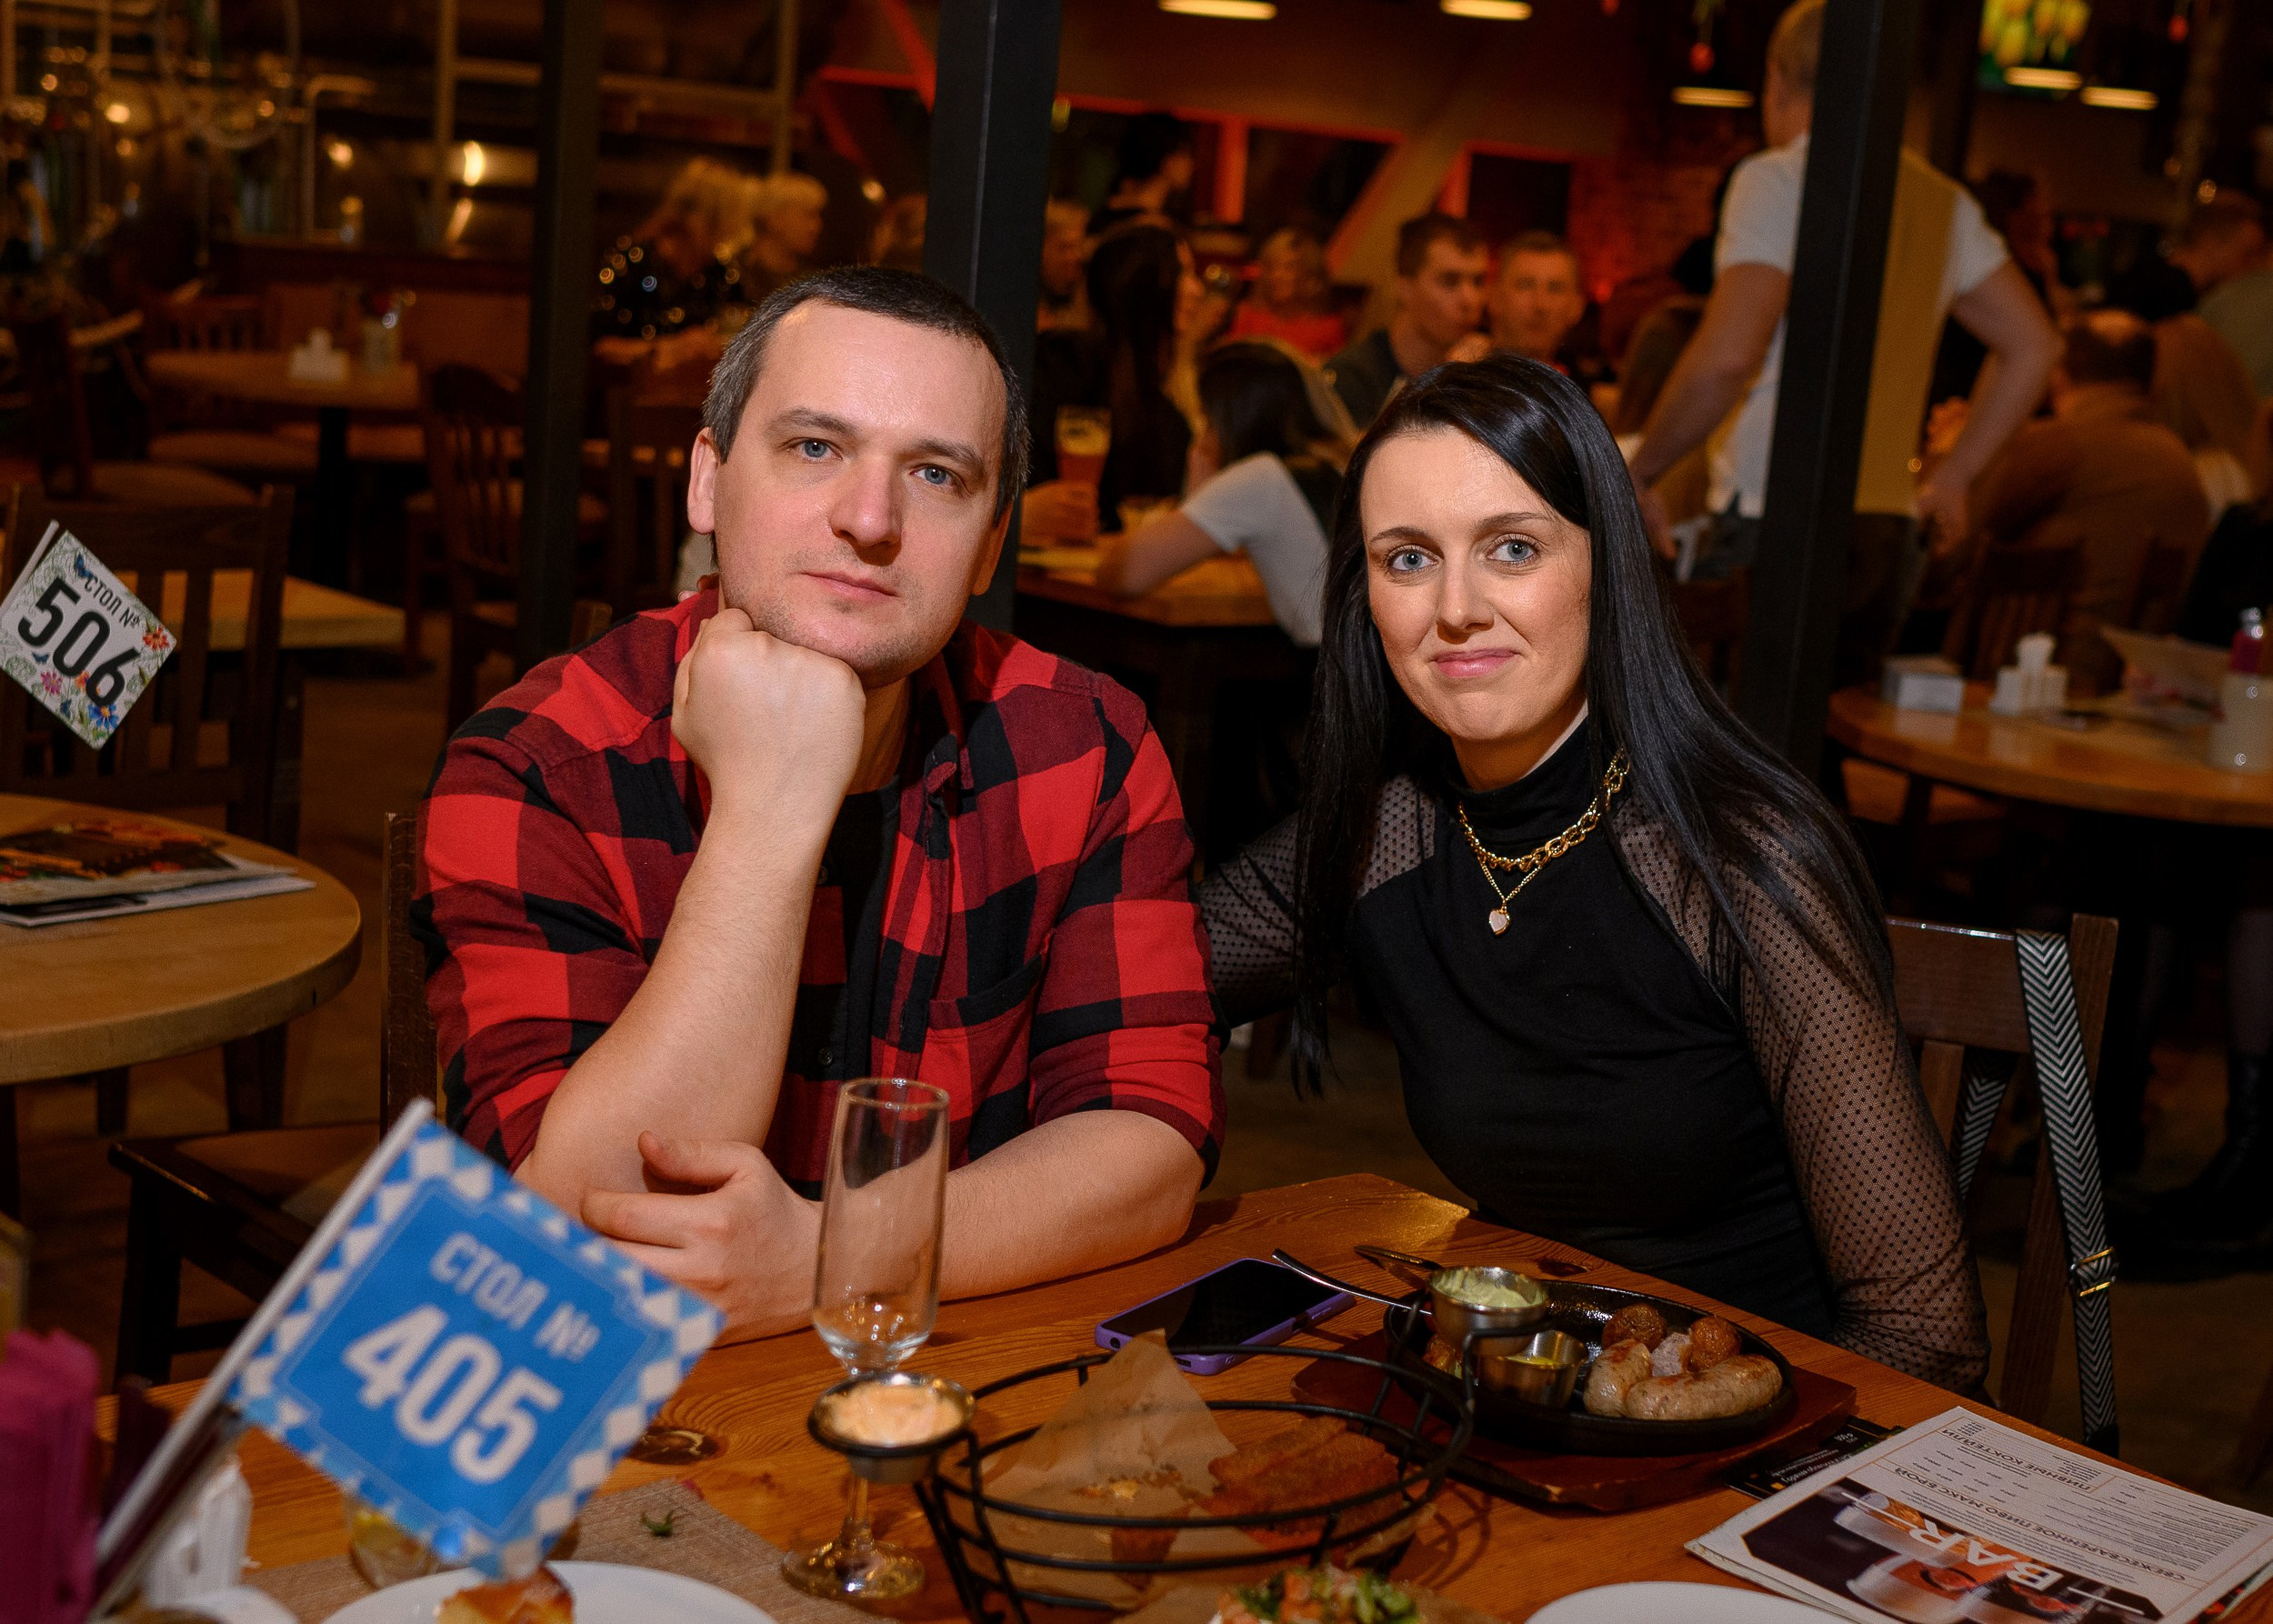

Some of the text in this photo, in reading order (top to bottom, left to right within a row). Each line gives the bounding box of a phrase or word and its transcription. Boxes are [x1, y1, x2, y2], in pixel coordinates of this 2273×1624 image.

[84, 576, 141, 627] СТОЛ №
[17, 576, 142, 707] 506
[429, 1232, 601, 1361] СТОЛ №
[340, 1302, 565, 1483] 405
[1942, 1428, 2021, 1465] КОКТЕЙЛИ
[1894, 1467, 1938, 1491] БРОЙ
[1936, 1486, 1983, 1511] МАКС
[2024, 1462, 2091, 1491] ПИВНЫЕ
[1985, 1506, 2035, 1529] ПИВО
[1909, 1518, 2065, 1591] BAR
[2036, 1523, 2186, 1580] СВЕЖЕСВАРЕННОЕ
